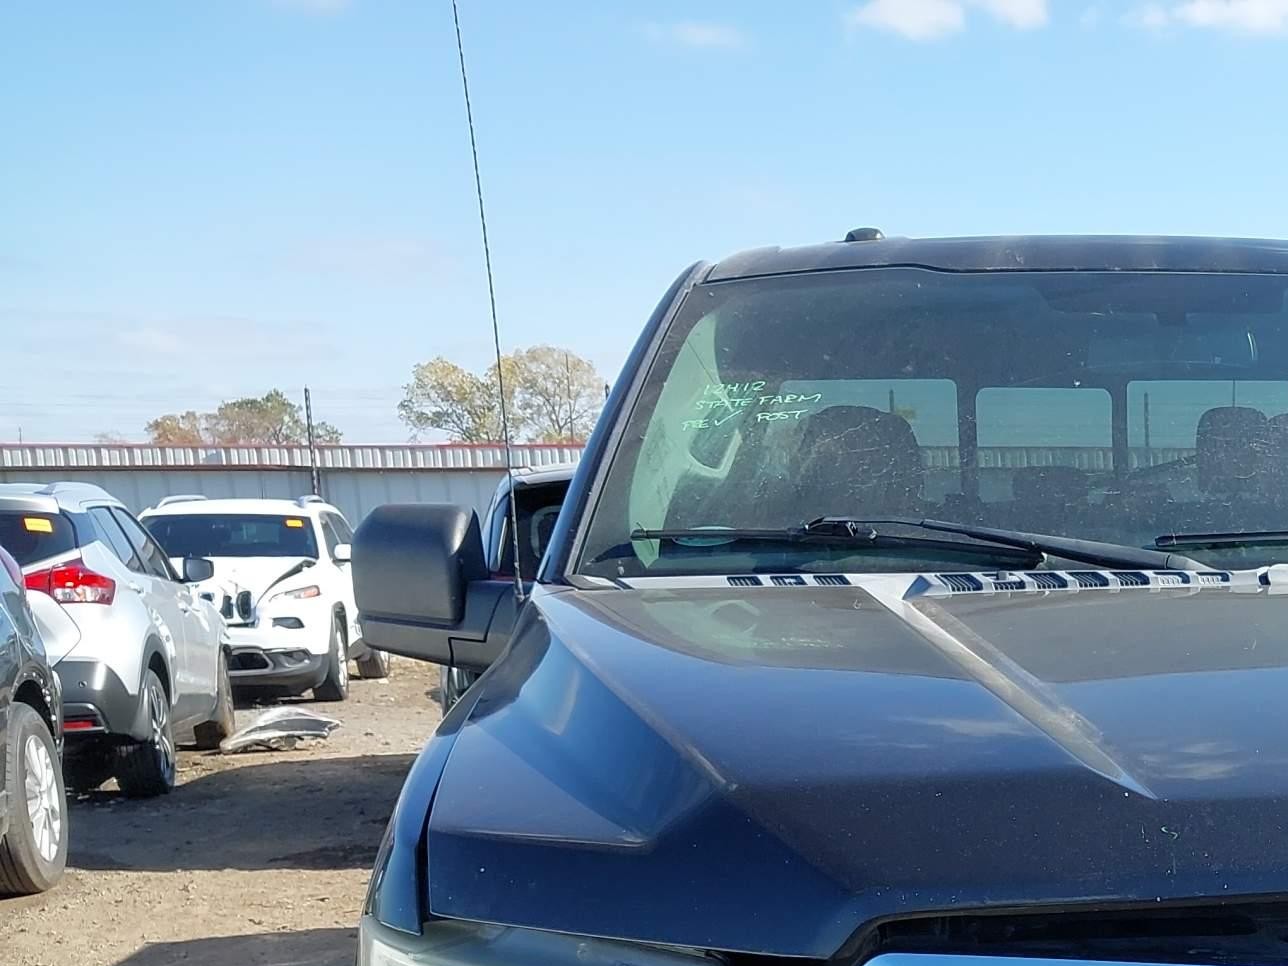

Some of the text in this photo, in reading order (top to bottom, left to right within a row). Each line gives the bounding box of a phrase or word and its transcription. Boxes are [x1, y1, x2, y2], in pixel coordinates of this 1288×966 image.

[695, 393, 822, 410] STATE FARM
[756, 409, 808, 422] POST
